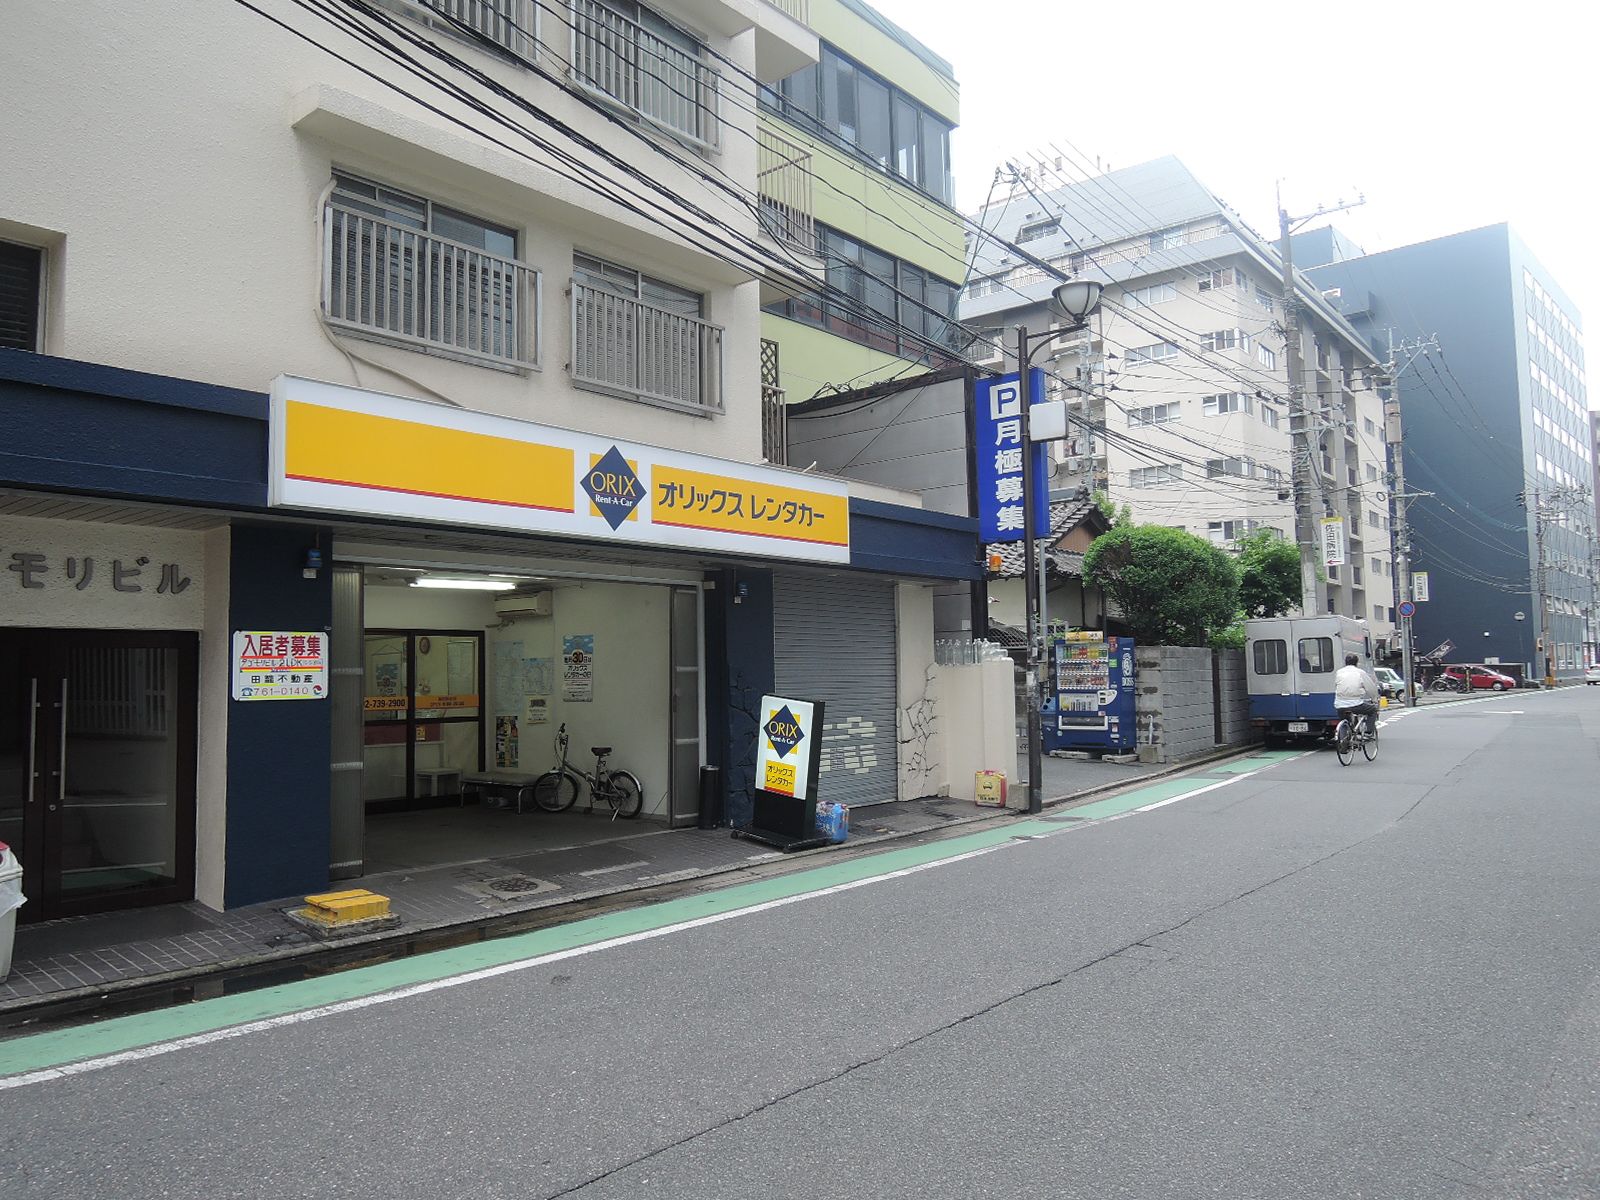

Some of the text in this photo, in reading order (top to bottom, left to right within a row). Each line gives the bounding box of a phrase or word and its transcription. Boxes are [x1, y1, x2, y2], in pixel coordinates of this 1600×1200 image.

[590, 471, 636, 497] ORIX
[995, 420, 1025, 531] 月極募集
[595, 494, 634, 508] Rent-A-Car
[658, 481, 825, 527] オリックス レンタカー
[8, 552, 192, 595] モリビル
[242, 635, 321, 656] 入居者募集
[254, 687, 309, 697] 761-0140
[768, 721, 798, 738] ORIX
[766, 774, 793, 787] レンタカー
[767, 765, 793, 777] オリックス
